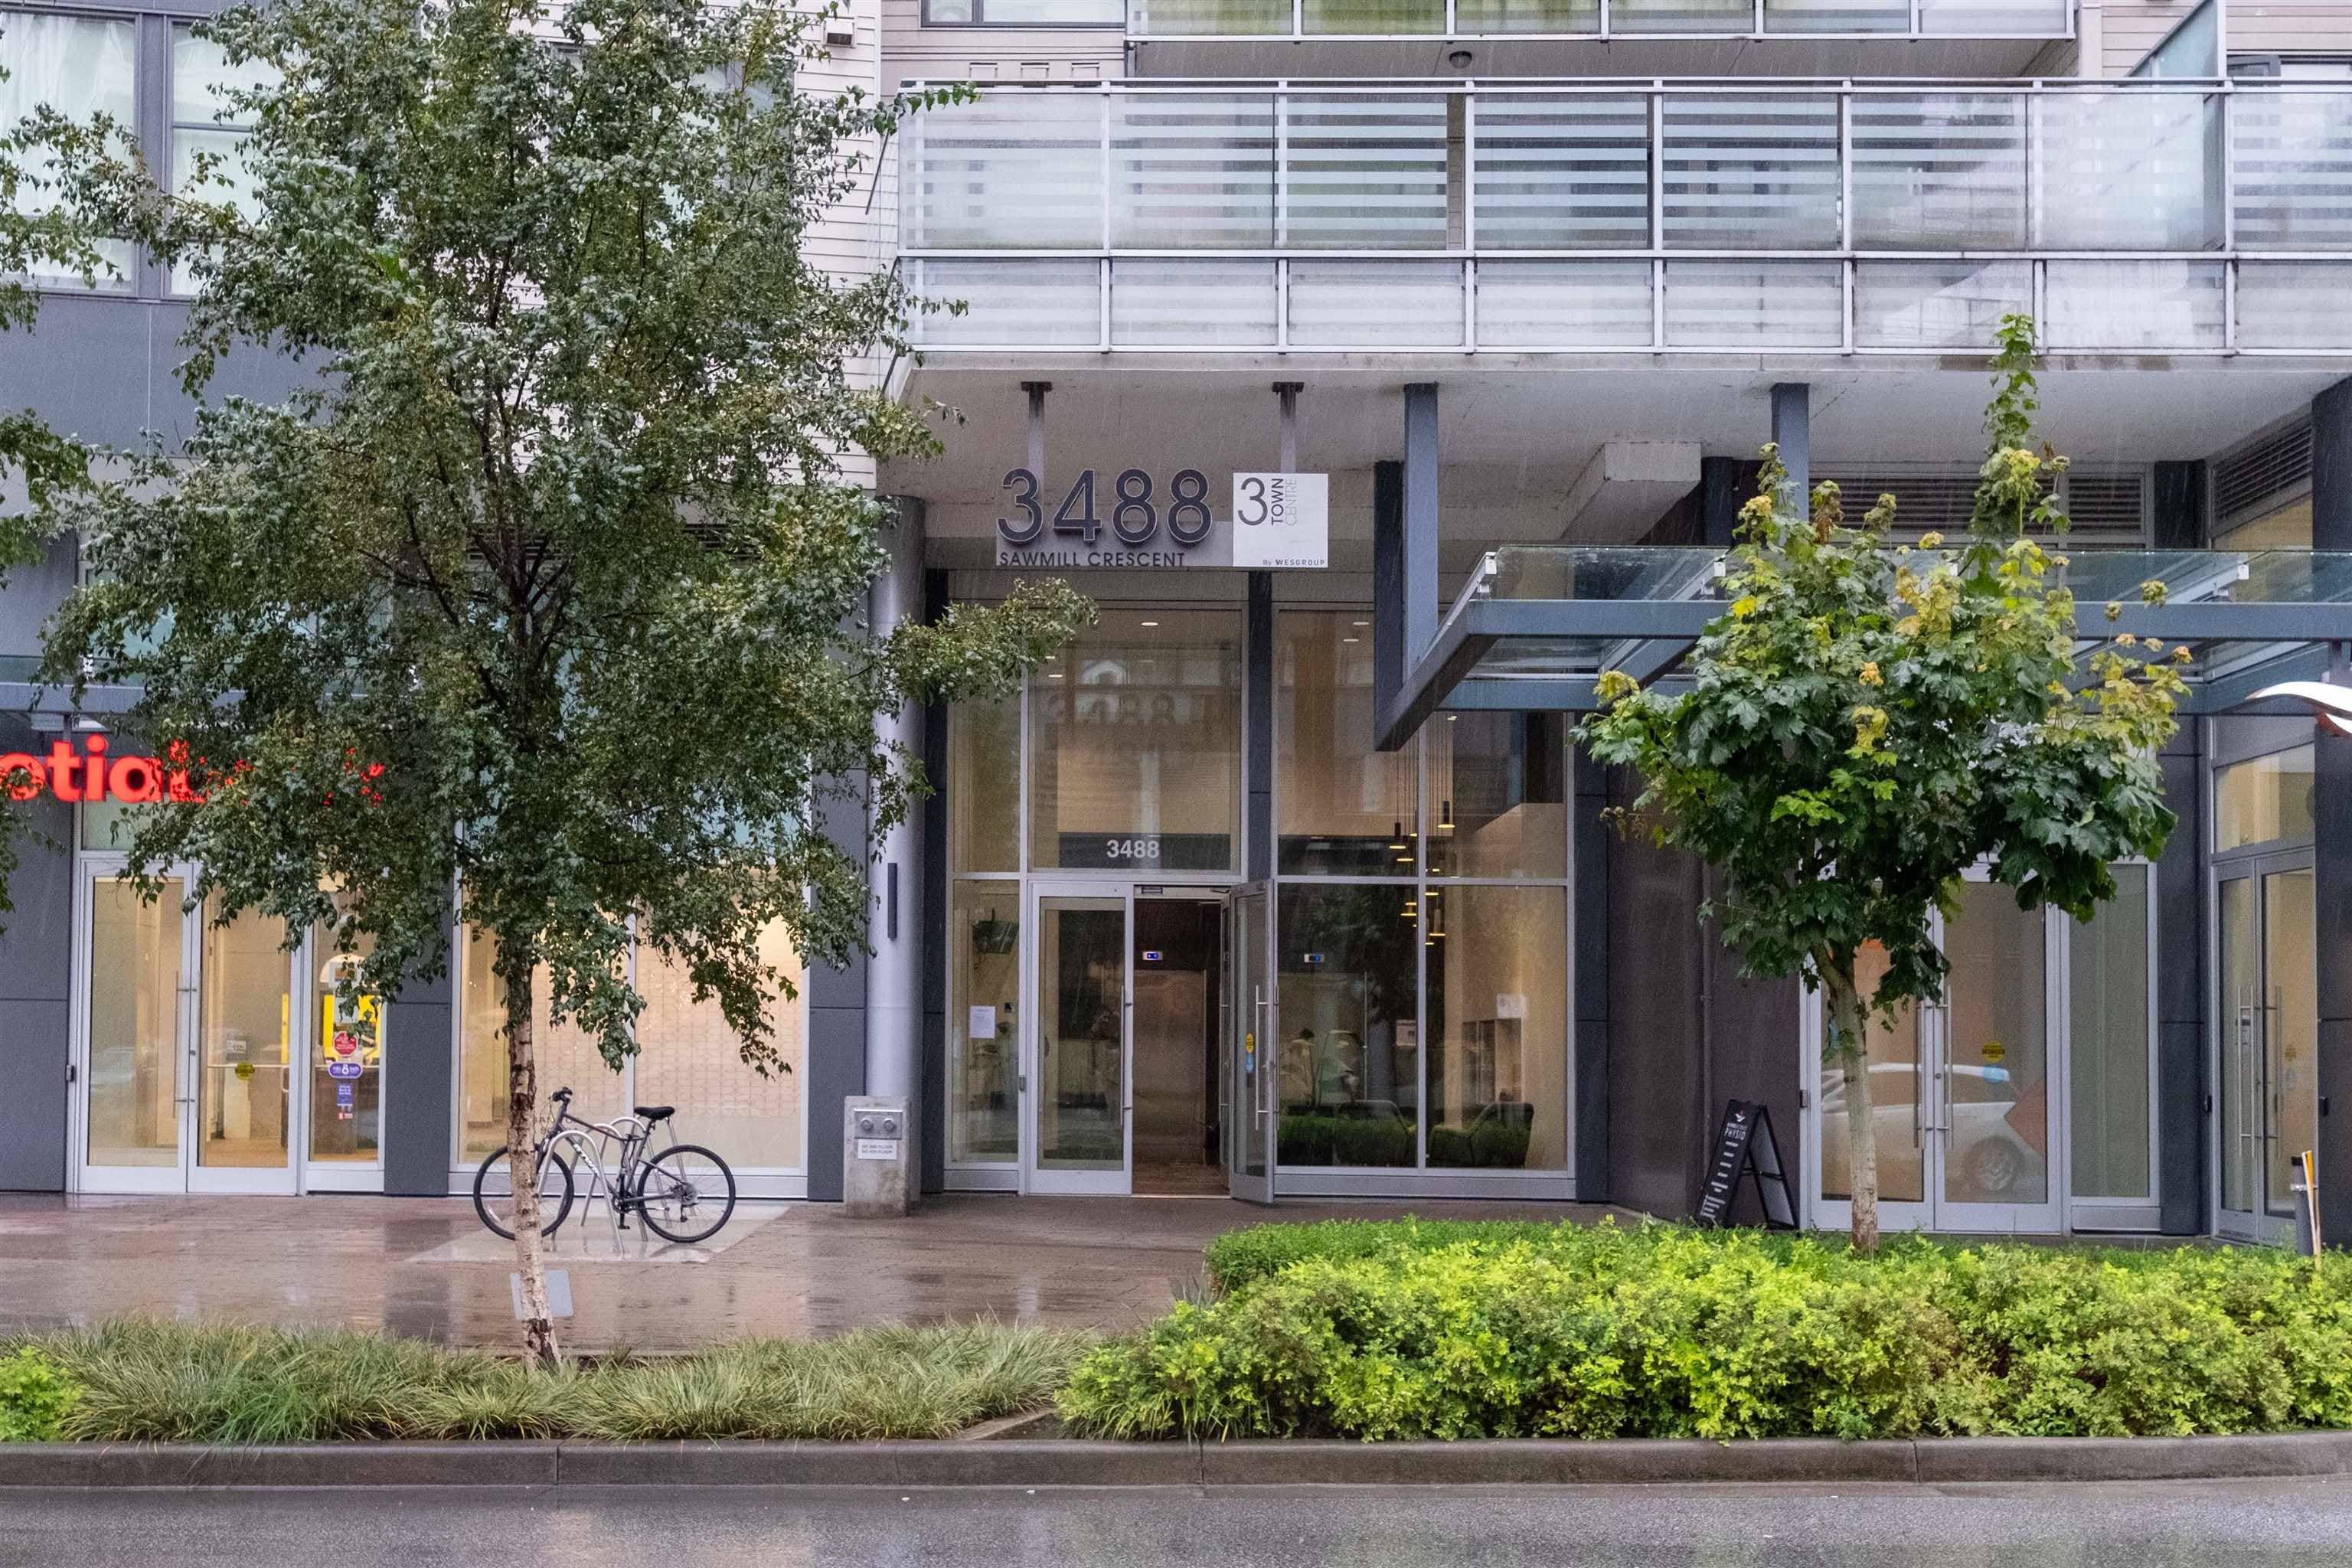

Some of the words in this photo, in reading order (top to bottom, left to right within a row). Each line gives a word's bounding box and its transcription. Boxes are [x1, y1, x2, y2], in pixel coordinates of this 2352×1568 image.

[997, 467, 1214, 544] 3488
[1237, 476, 1268, 526] 3
[1271, 478, 1284, 525] TOWN
[1285, 477, 1297, 526] CENTRE
[998, 551, 1079, 567] SAWMILL
[1087, 551, 1186, 567] CRESCENT
[1106, 839, 1160, 859] 3488
